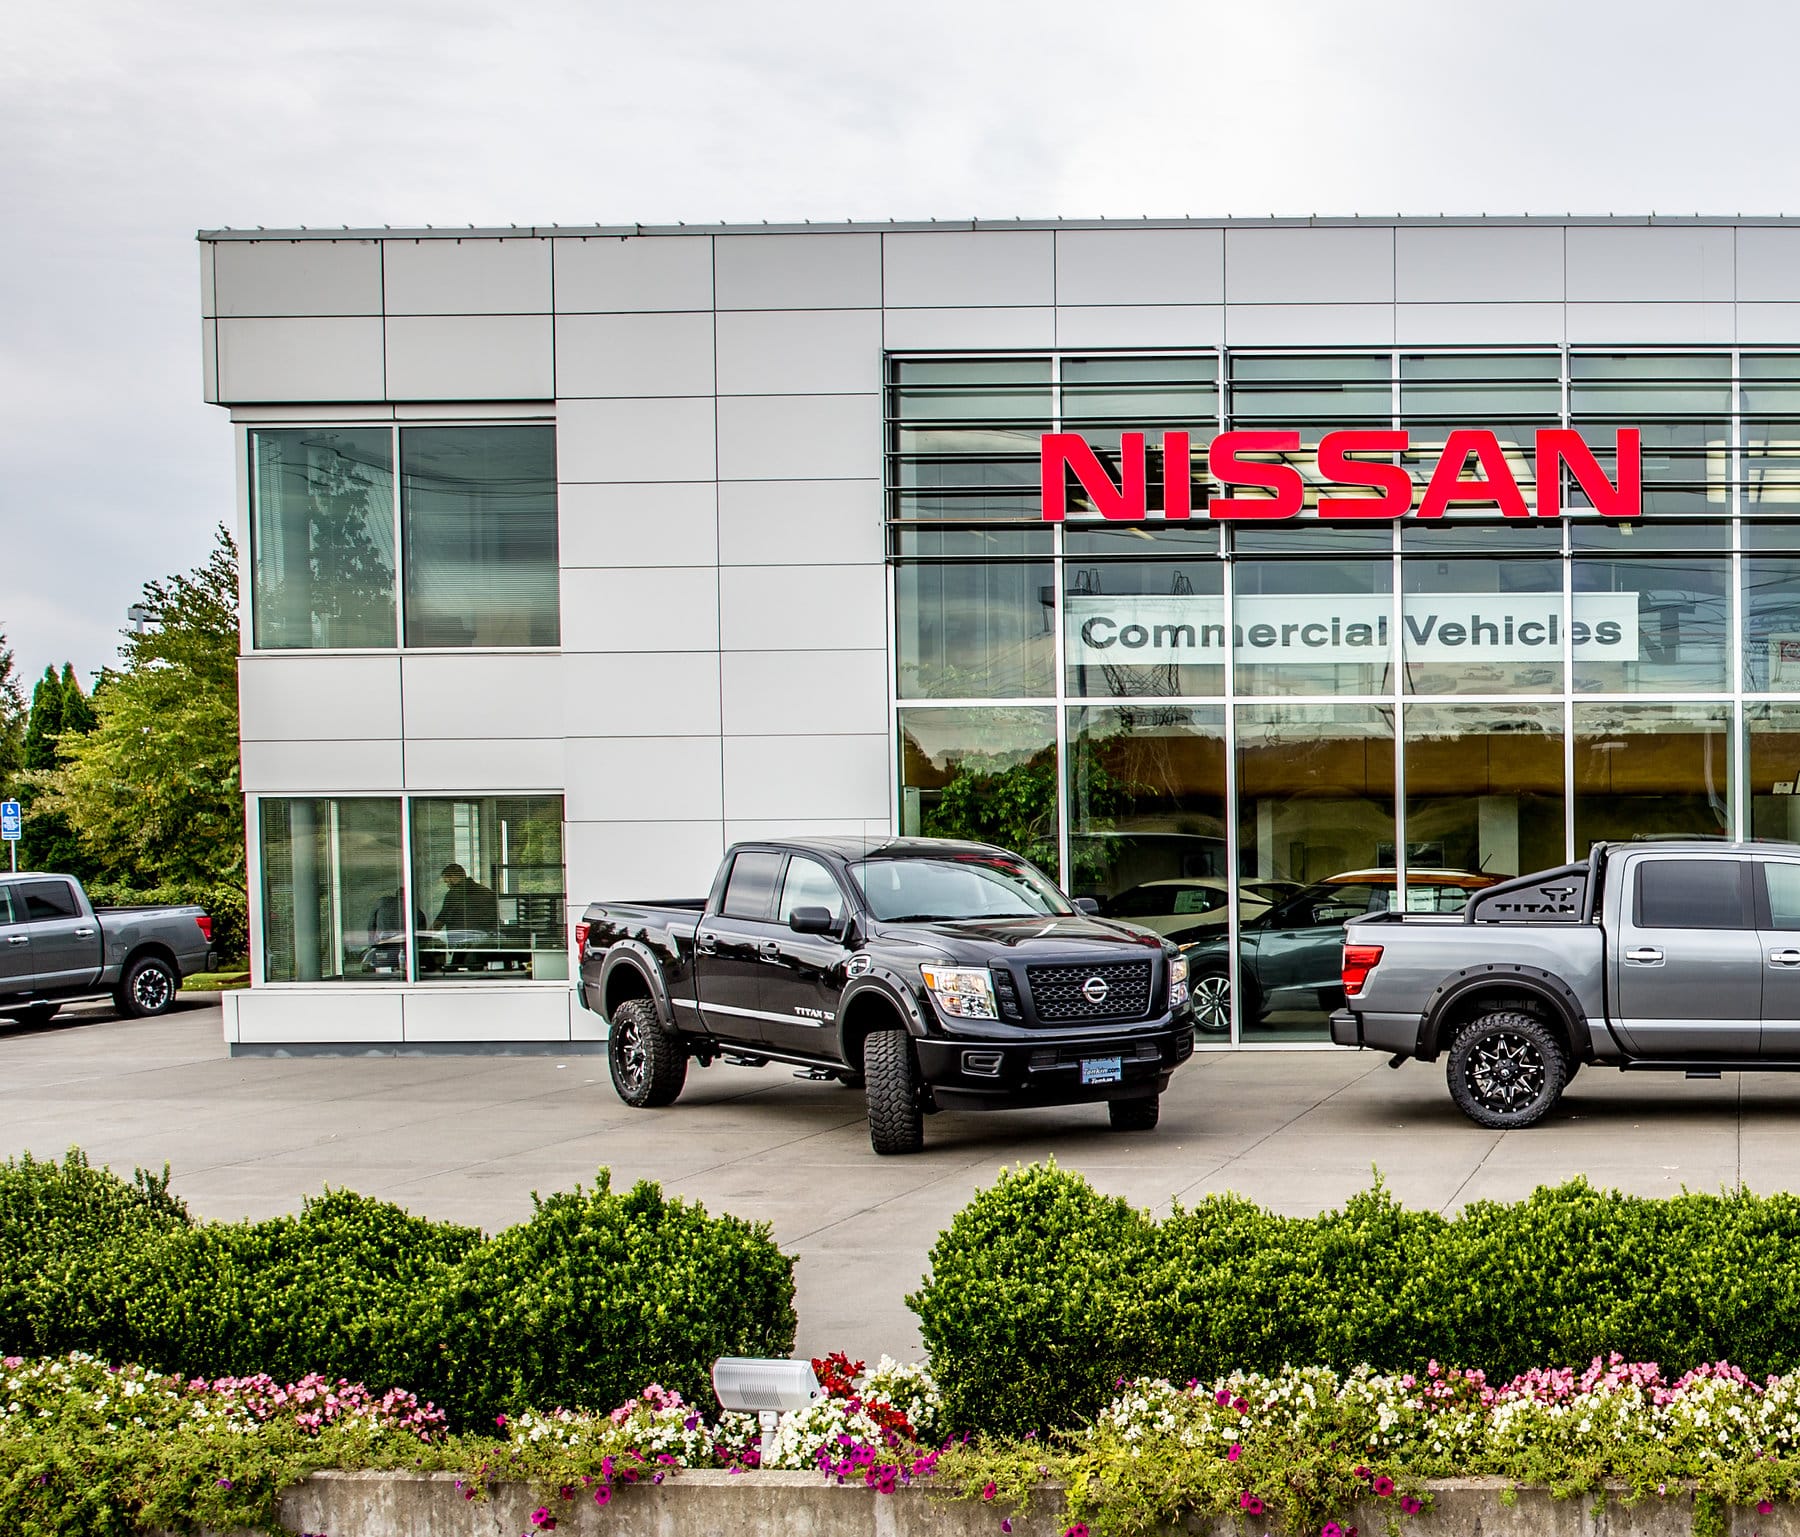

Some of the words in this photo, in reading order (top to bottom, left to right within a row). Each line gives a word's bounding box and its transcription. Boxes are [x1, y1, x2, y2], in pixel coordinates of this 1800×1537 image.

[1041, 428, 1642, 521] NISSAN
[1080, 615, 1388, 649] Commercial
[1404, 614, 1623, 647] Vehicles
[1494, 903, 1576, 914] TITAN
[794, 1006, 823, 1018] TITAN
